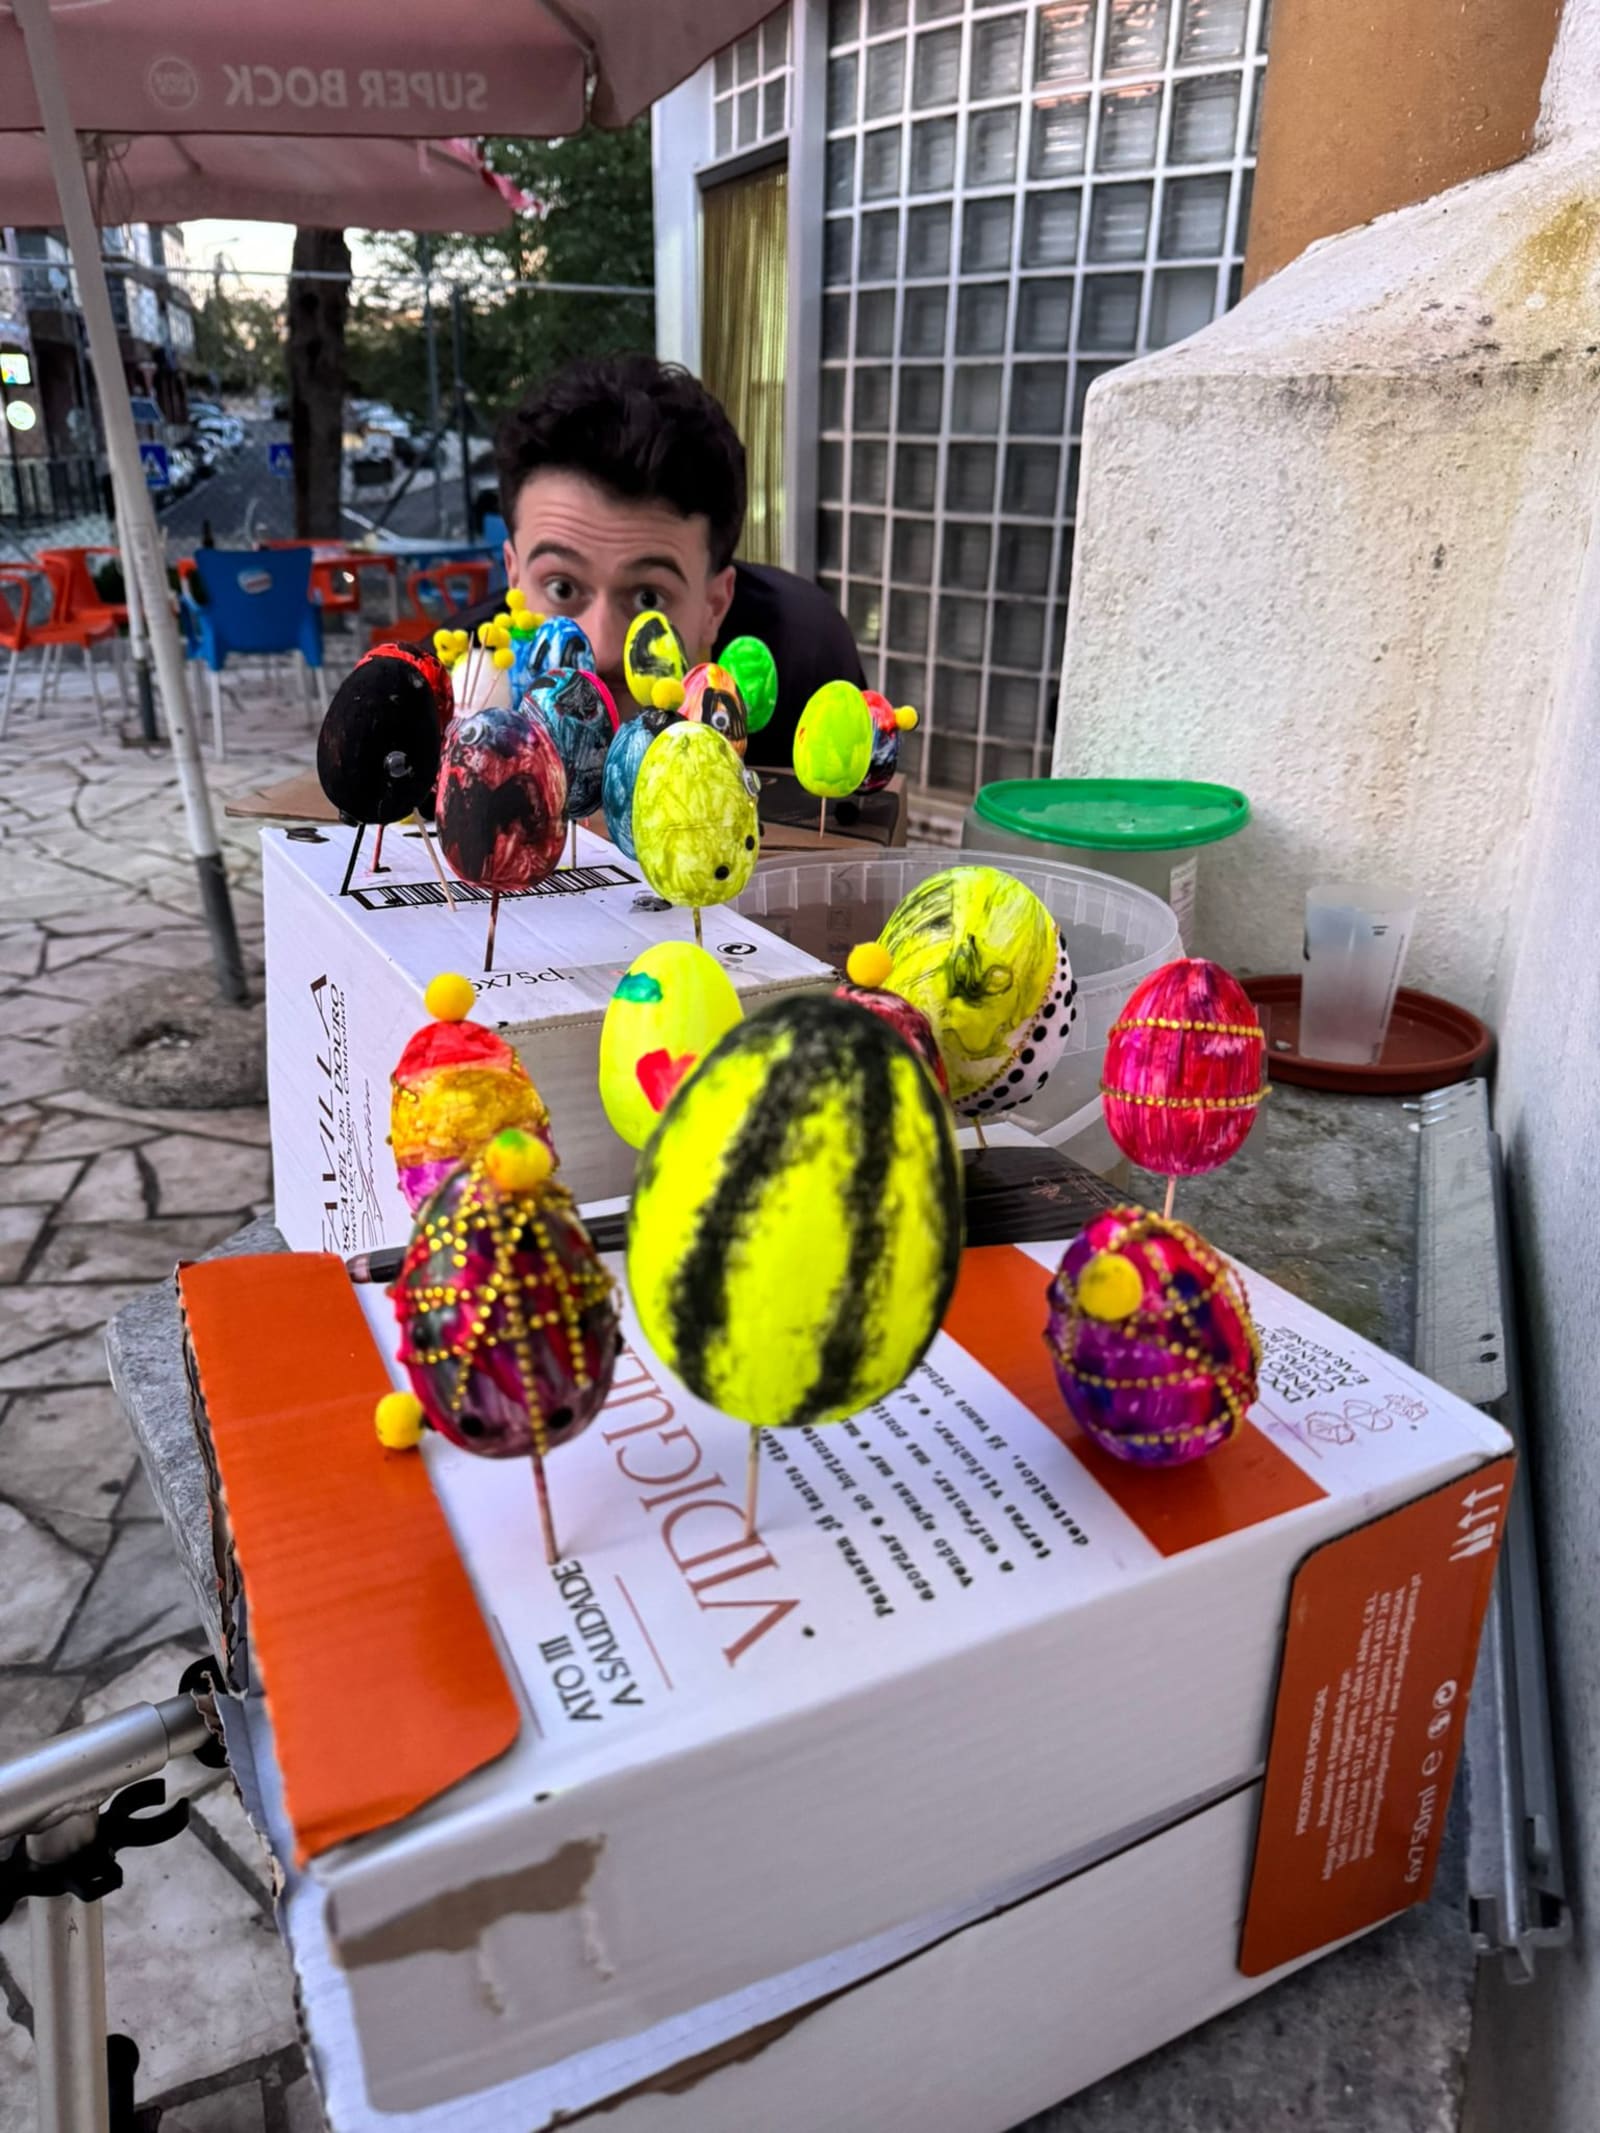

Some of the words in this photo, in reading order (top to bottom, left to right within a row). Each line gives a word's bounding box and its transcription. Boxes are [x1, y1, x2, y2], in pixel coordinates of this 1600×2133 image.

[331, 983, 343, 1096] DOURO
[340, 991, 349, 1095] Controlada
[785, 1466, 824, 1512] tantos
[867, 1455, 894, 1477] mar
[853, 1494, 875, 1512] no
[871, 1515, 885, 1527] e
[891, 1481, 936, 1531] apenas
[1003, 1504, 1051, 1559] terras
[933, 1538, 973, 1588] vendo
[999, 1560, 1014, 1572] a
[551, 1560, 632, 1683] SAUDADE
[538, 1634, 575, 1664] III
[552, 1664, 604, 1721] ATO
[610, 1681, 645, 1705] A
[1307, 1684, 1329, 1755] PORTUGAL
[1304, 1754, 1318, 1774] DE
[1296, 1773, 1315, 1836] PRODUTO
[1404, 1784, 1438, 1882] 6x750ml
